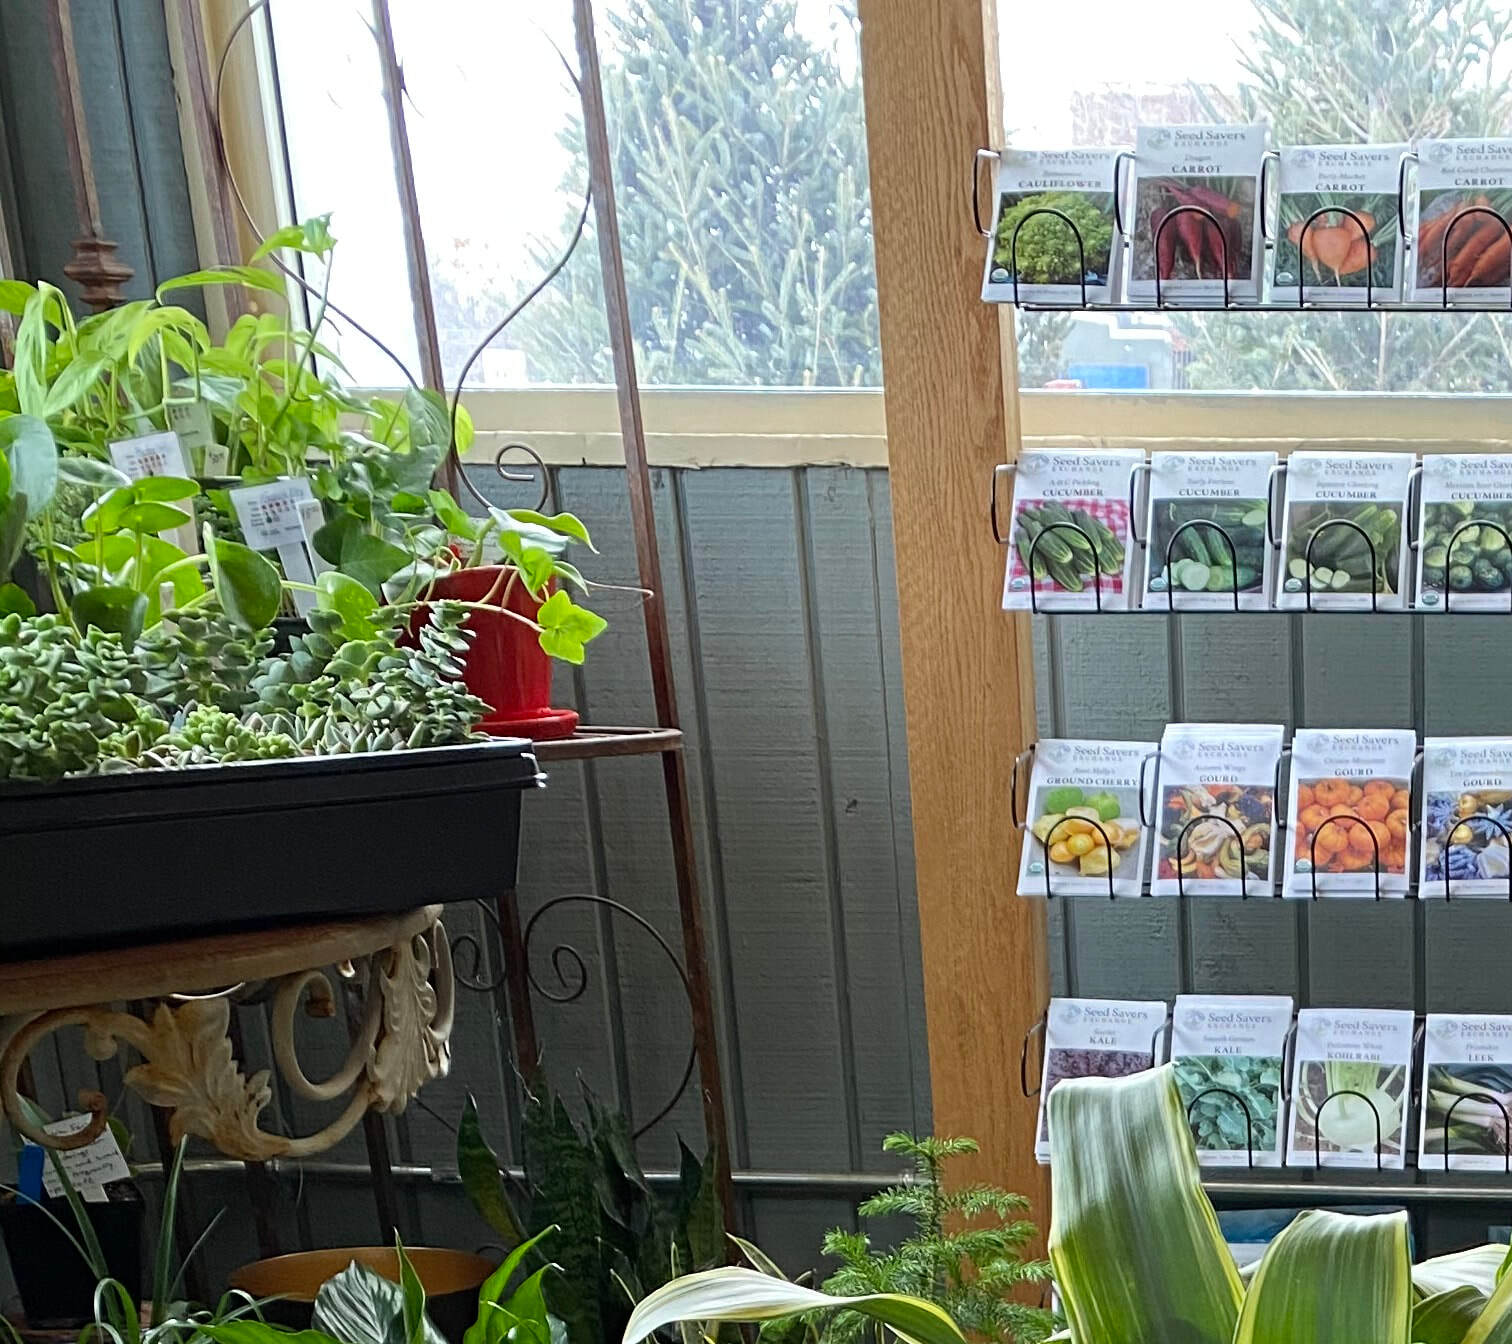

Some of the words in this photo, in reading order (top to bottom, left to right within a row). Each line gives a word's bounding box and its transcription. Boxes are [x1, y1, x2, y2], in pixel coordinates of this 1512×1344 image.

[1171, 165, 1222, 173] CARROT
[1018, 180, 1102, 188] CAULIFLOWER
[1454, 178, 1505, 186] CARROT
[1042, 489, 1104, 497] CUCUMBER
[1178, 489, 1240, 497] CUCUMBER
[1315, 491, 1377, 499] CUCUMBER
[1451, 492, 1512, 500] CUCUMBER
[1334, 768, 1373, 777] GOURD
[1047, 777, 1094, 786] GROUND
[1095, 777, 1138, 786] CHERRY
[1200, 775, 1238, 783] GOURD
[1463, 779, 1502, 788] GOURD
[1089, 1036, 1117, 1045] KALE
[1214, 1046, 1242, 1055] KALE
[1469, 1054, 1494, 1062] LEEK
